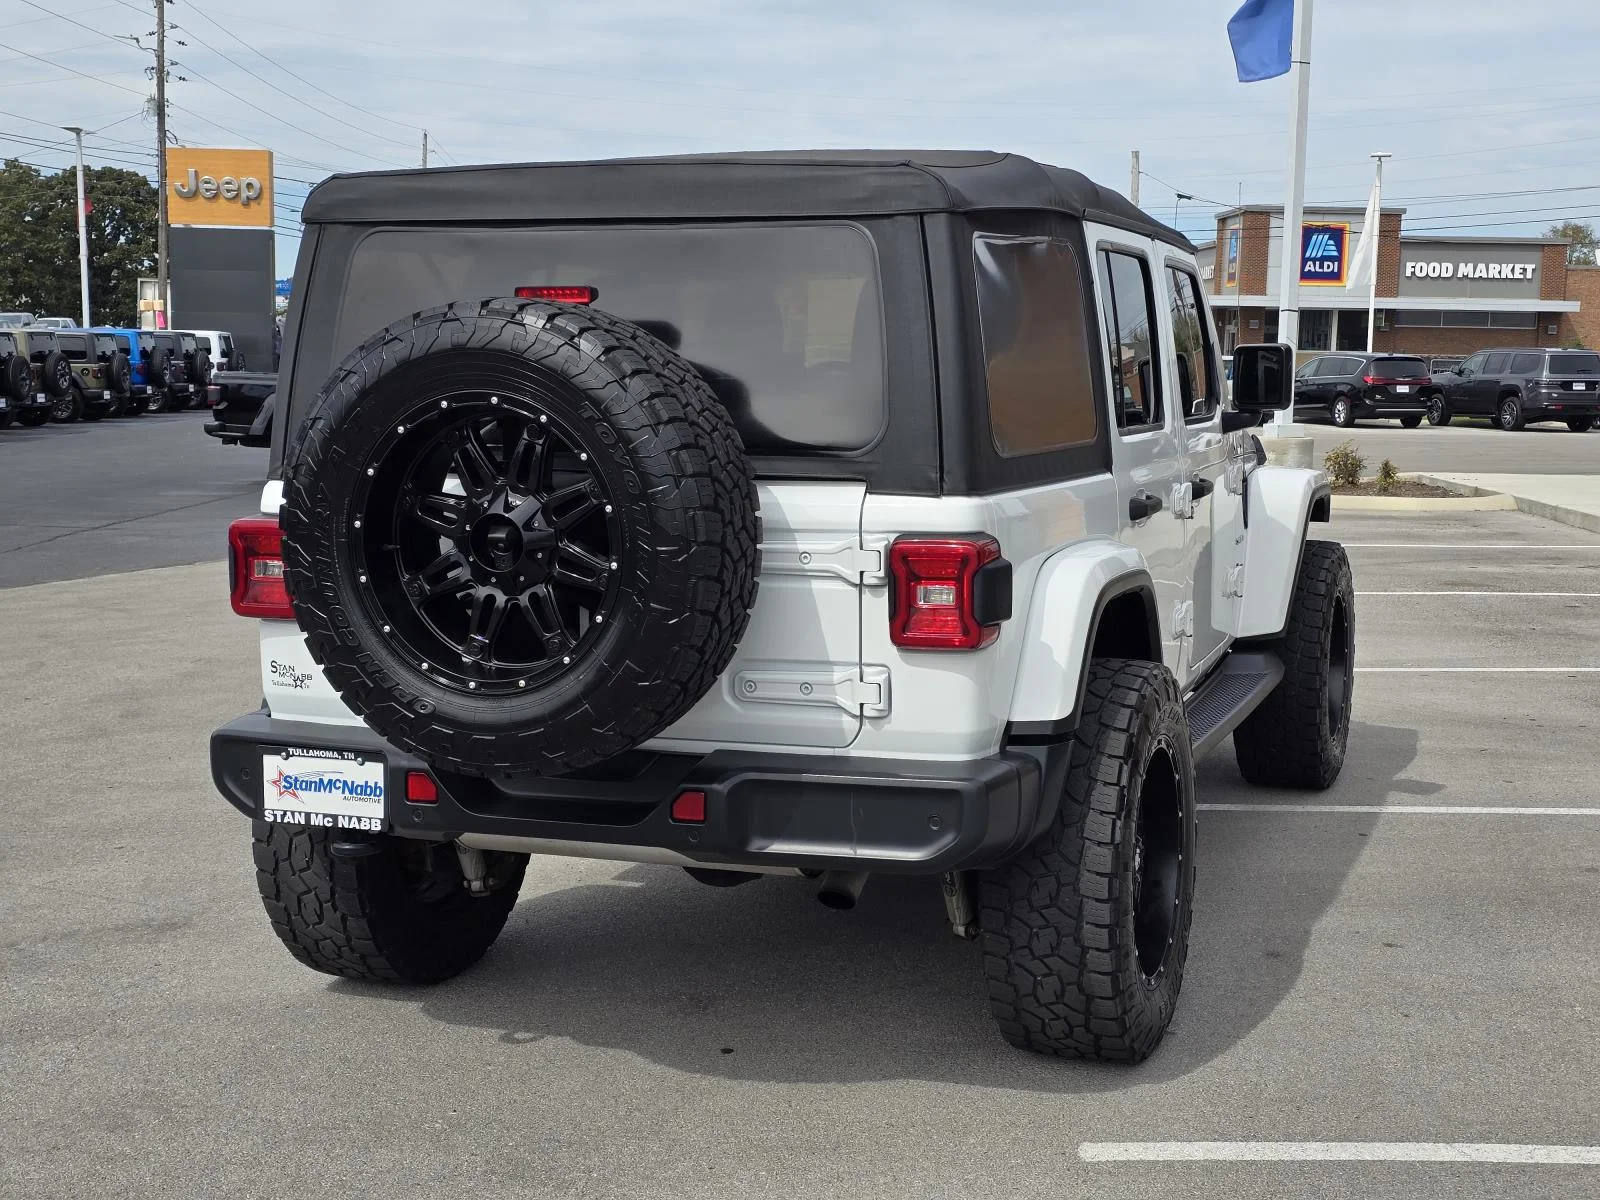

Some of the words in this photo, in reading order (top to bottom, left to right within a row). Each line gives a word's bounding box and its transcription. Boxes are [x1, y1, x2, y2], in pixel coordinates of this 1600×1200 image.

[174, 168, 261, 205] Jeep
[1304, 260, 1339, 273] ALDI
[1405, 261, 1454, 278] FOOD
[1457, 262, 1536, 279] MARKET
[270, 660, 296, 674] STAN
[288, 748, 342, 760] TULLAHOMA,
[343, 751, 355, 760] TN
[342, 795, 383, 804] AUTOMOTIVE
[264, 809, 306, 825] STAN
[310, 813, 334, 827] Mc
[337, 815, 383, 831] NABB
